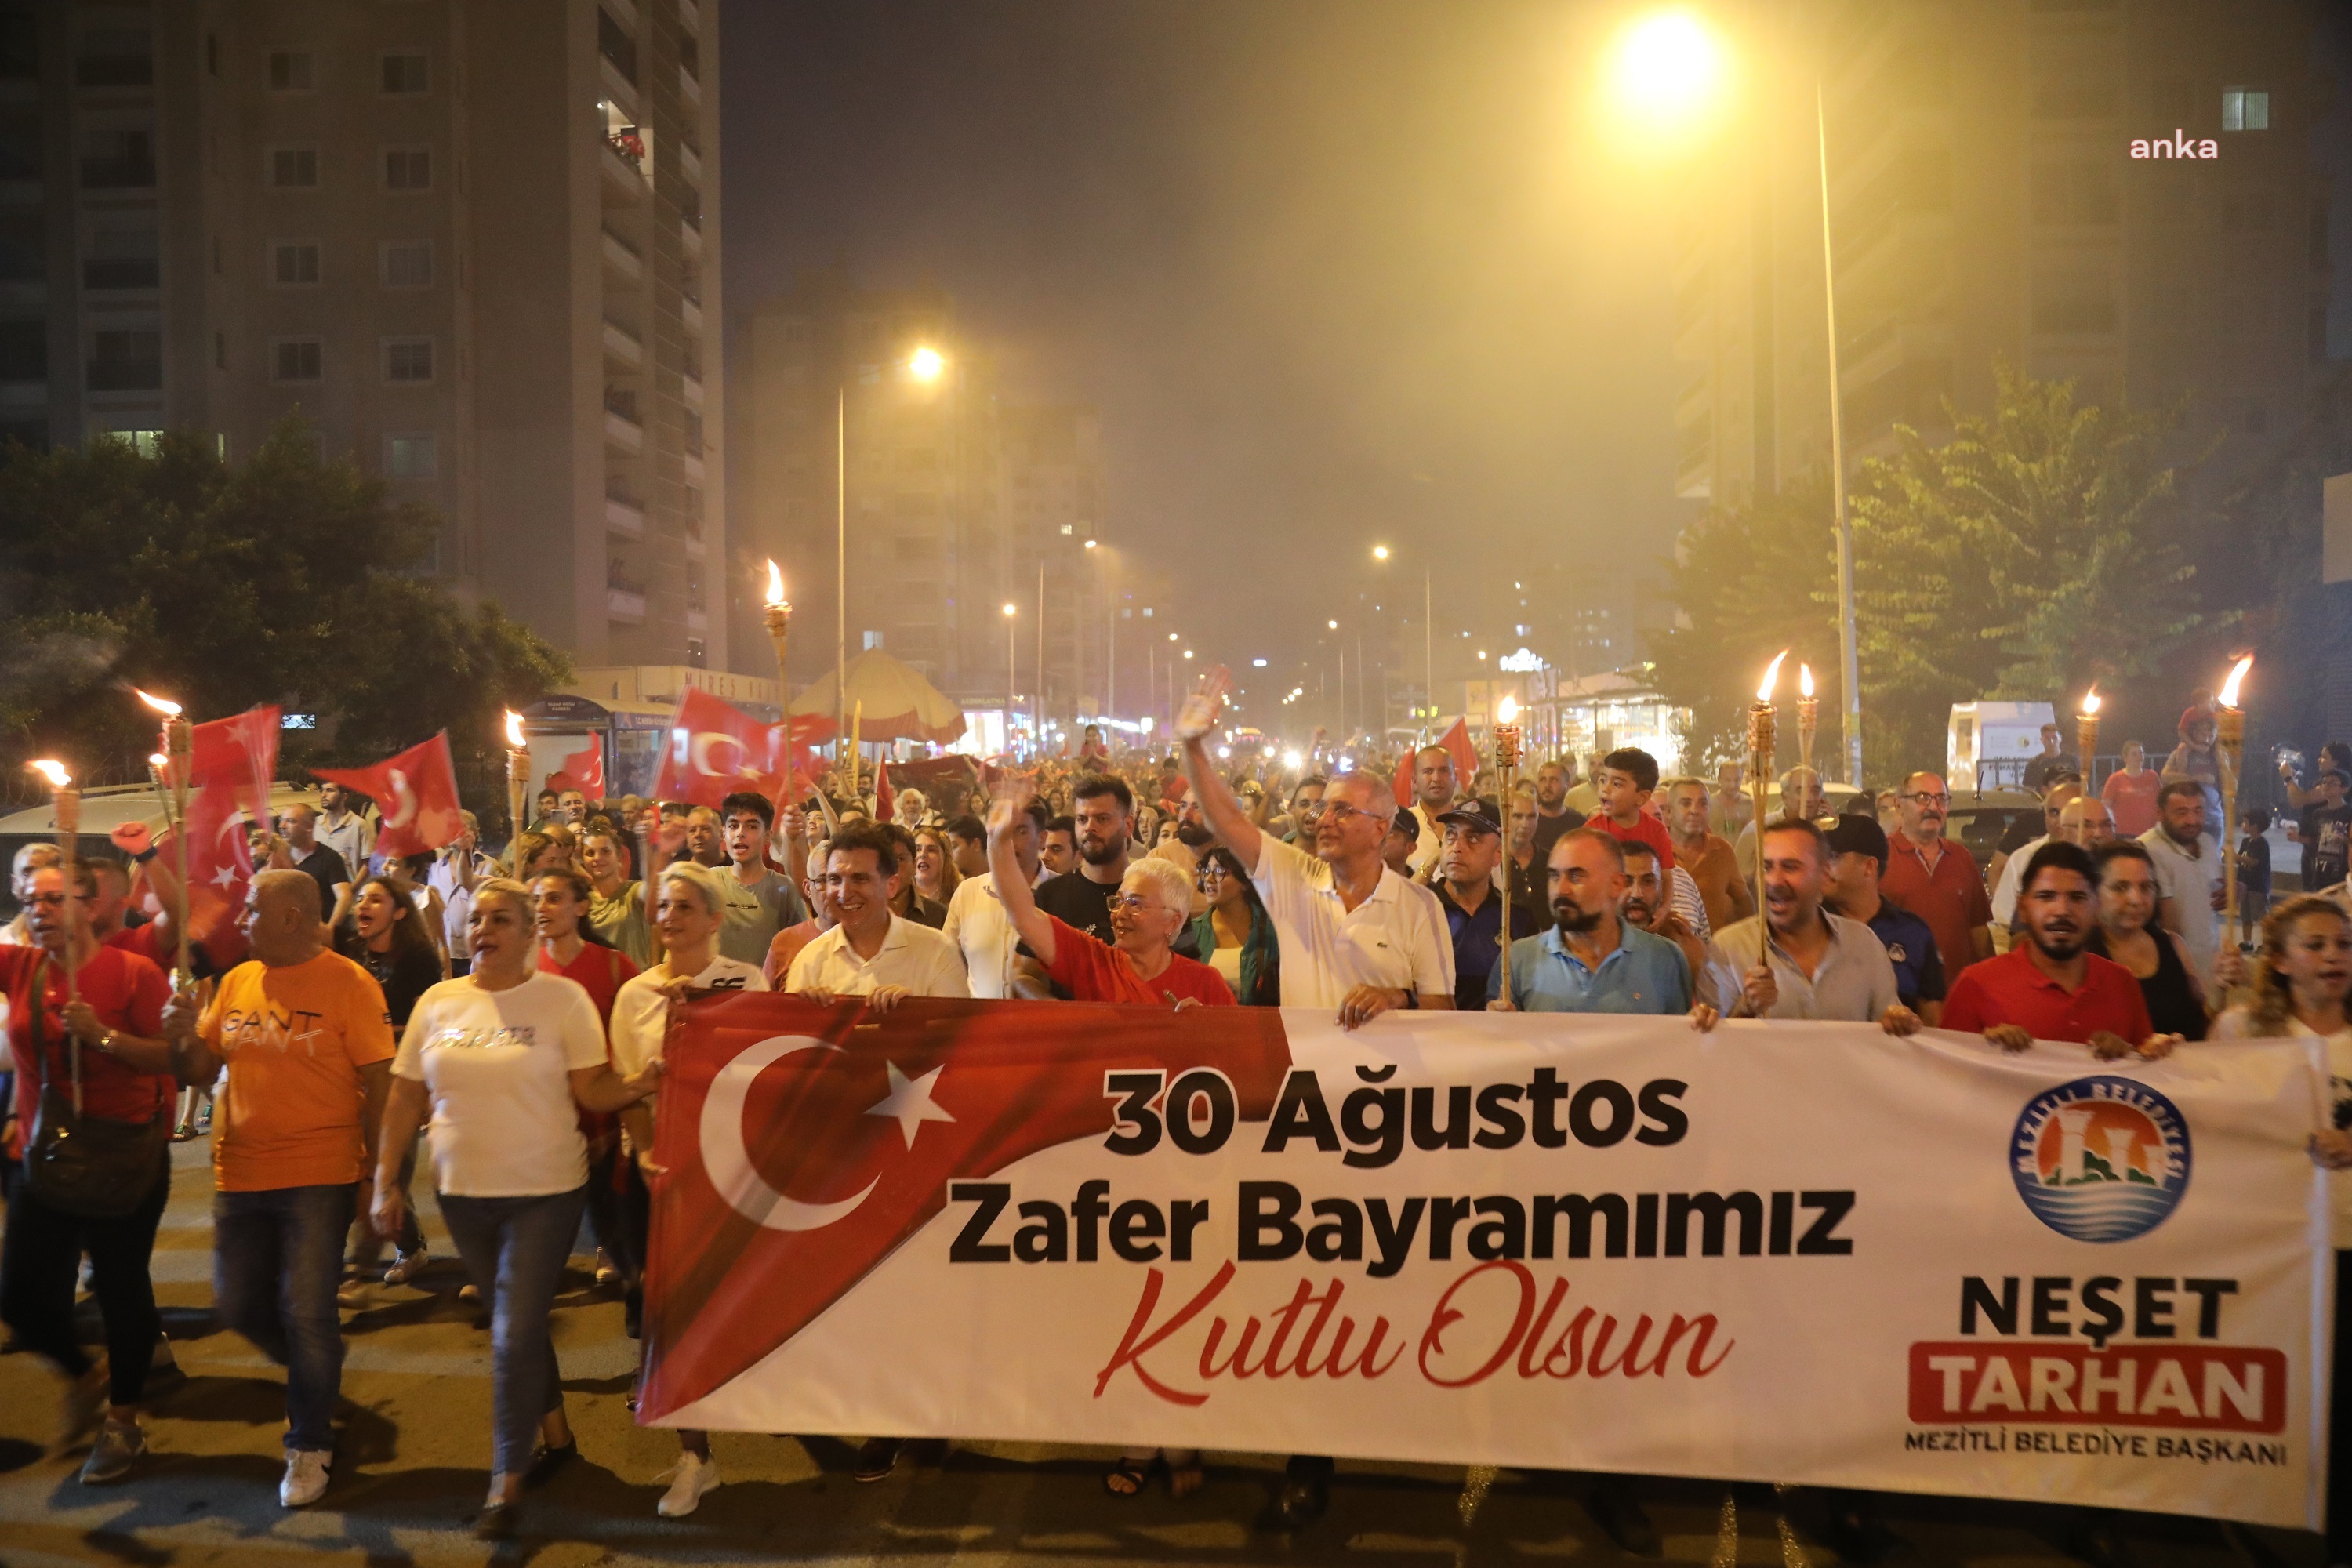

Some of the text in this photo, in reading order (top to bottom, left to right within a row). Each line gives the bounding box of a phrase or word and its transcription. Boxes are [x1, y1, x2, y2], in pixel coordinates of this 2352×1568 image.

[223, 1009, 323, 1032] GANT
[1103, 1064, 1689, 1170] 30 Ağustos
[949, 1179, 1857, 1279] Zafer Bayramımız
[1093, 1259, 1734, 1407] Kutlu Olsun
[1961, 1276, 2238, 1348] NEŞET
[1929, 1355, 2264, 1421] TARHAN
[1905, 1426, 2287, 1466] MEZİTLİ BELEDİYE BAŞKANI
